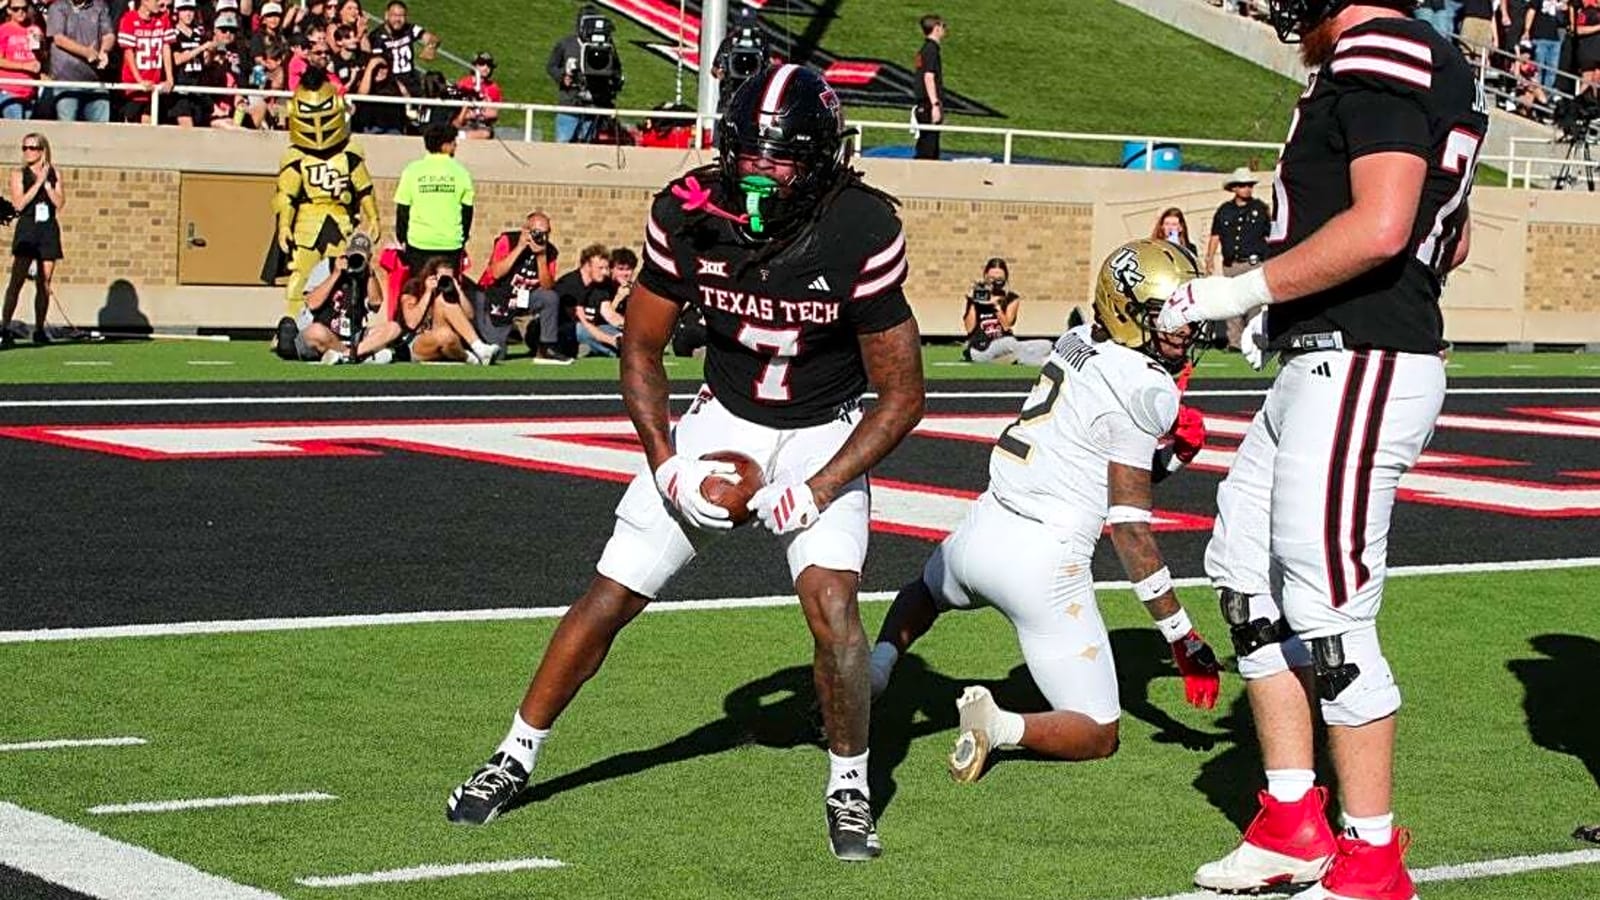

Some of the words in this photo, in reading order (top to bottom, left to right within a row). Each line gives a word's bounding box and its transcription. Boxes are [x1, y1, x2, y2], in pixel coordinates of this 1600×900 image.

[136, 38, 162, 70] 23
[307, 163, 350, 197] UCF
[700, 285, 774, 322] TEXAS
[780, 301, 840, 324] TECH
[737, 323, 801, 402] 7
[995, 361, 1065, 463] 2
